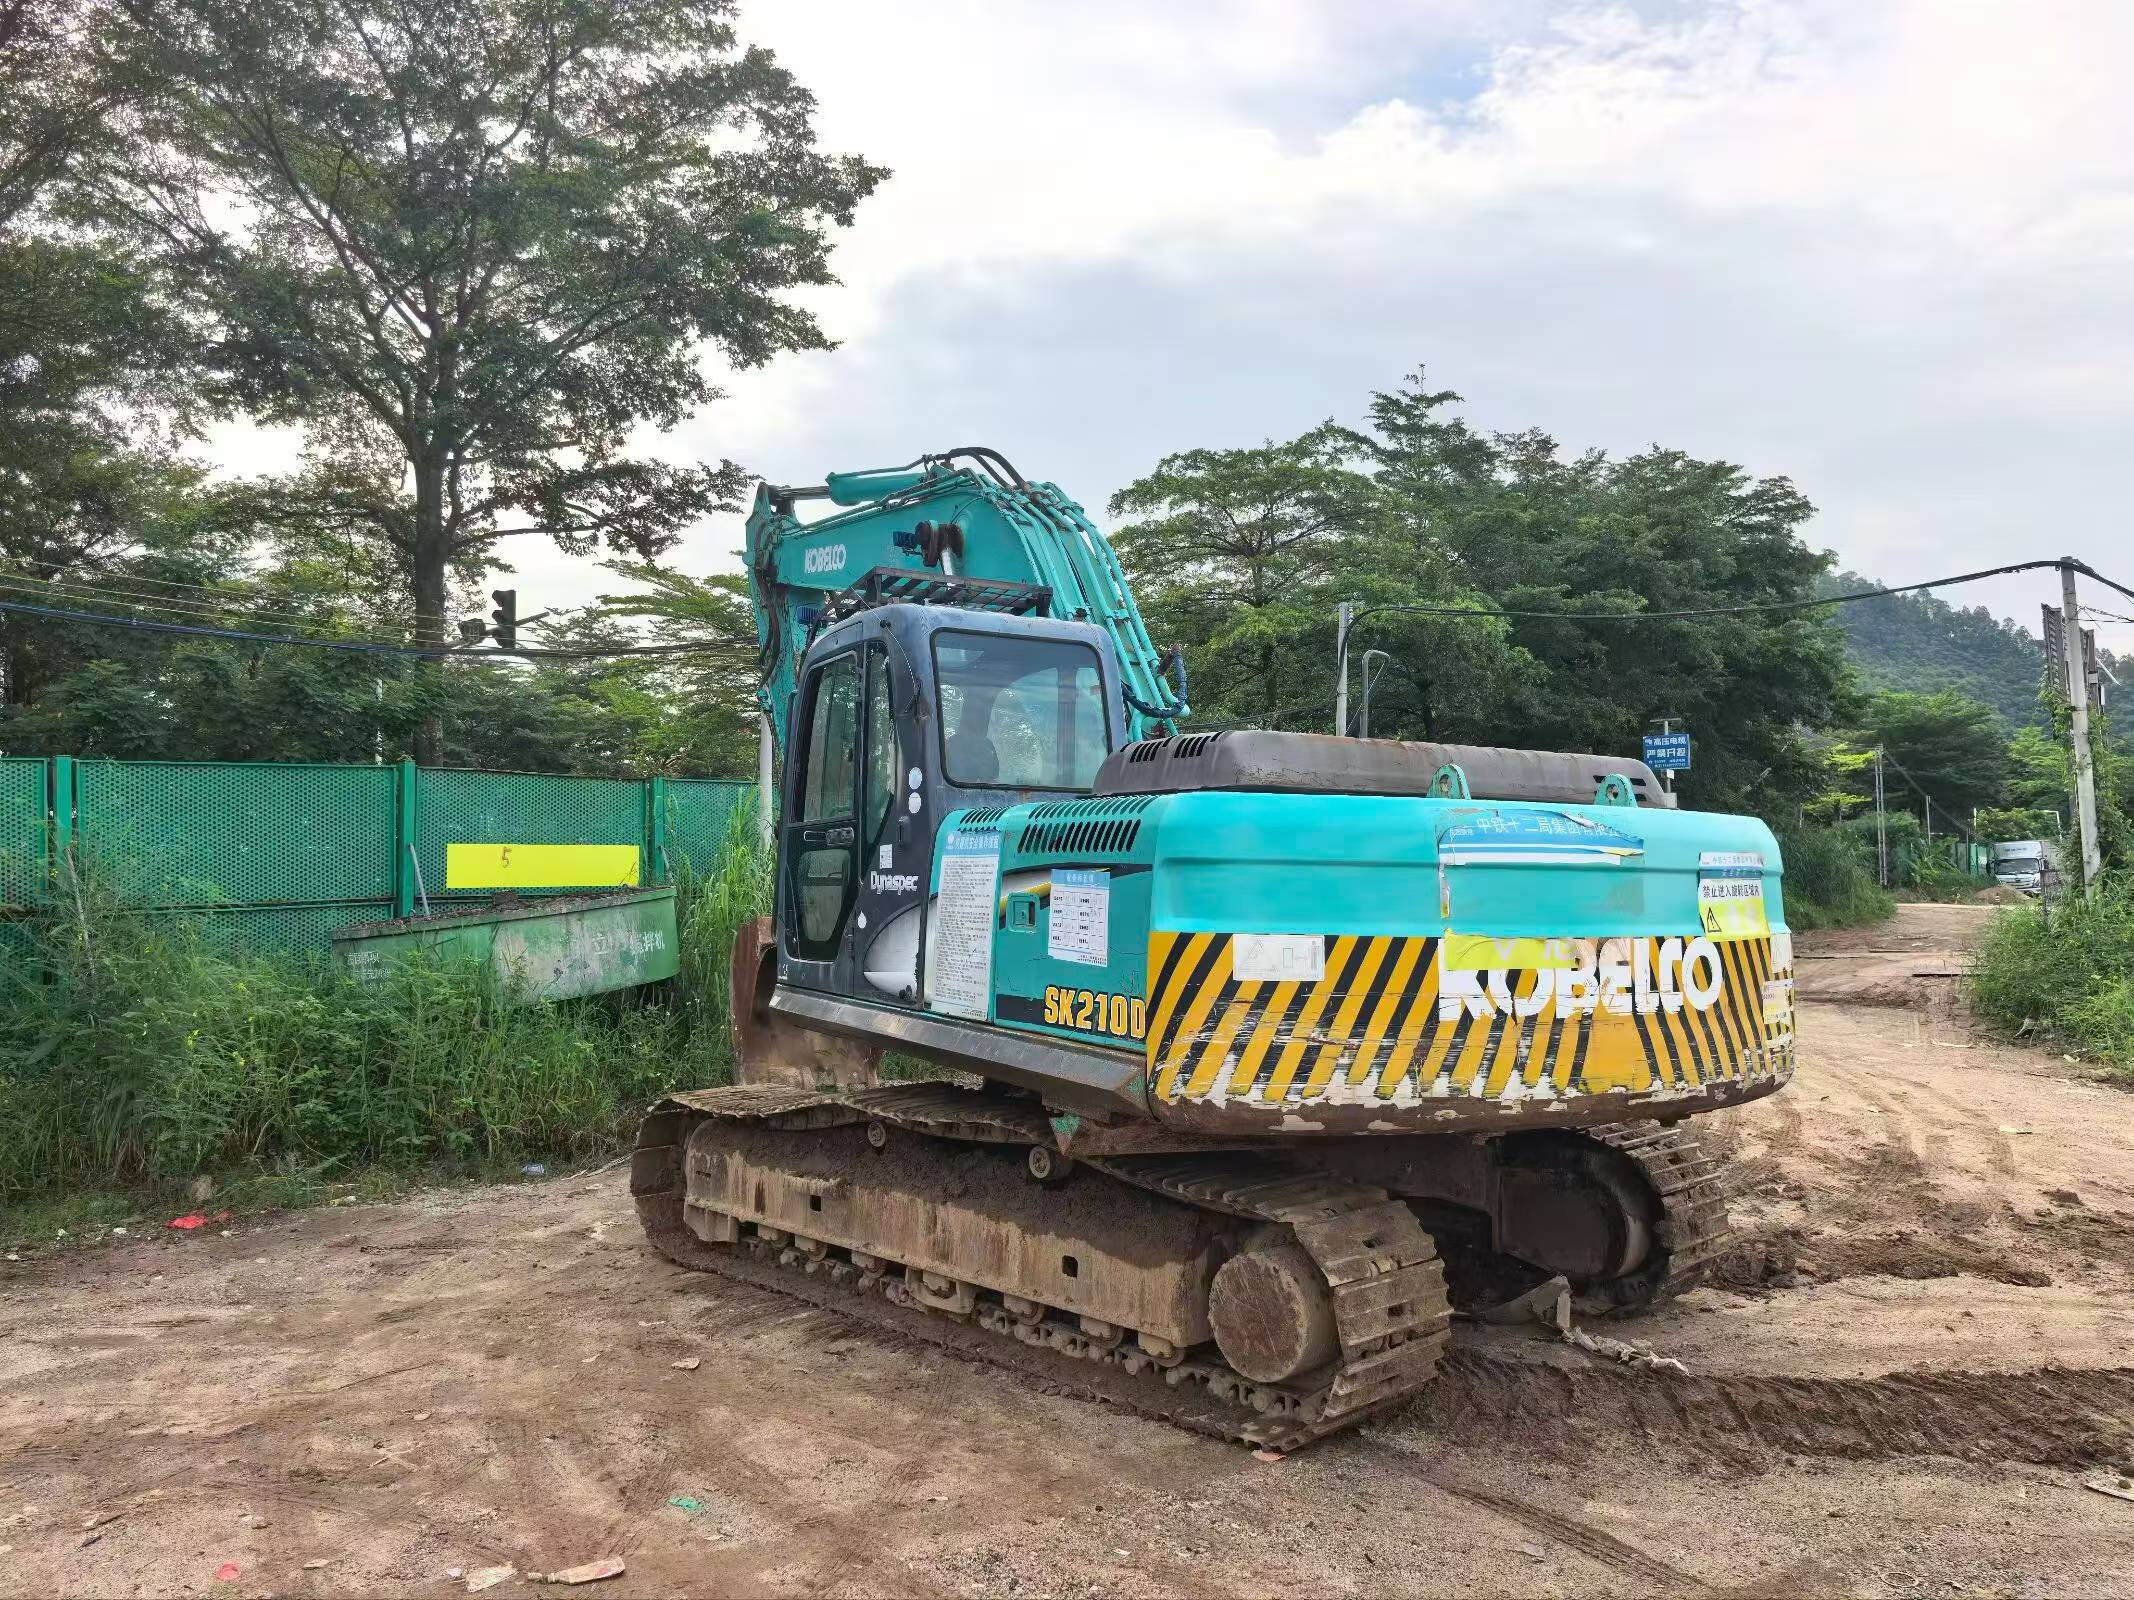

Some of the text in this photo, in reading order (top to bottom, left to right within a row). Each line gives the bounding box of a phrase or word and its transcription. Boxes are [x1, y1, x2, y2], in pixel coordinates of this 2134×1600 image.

[805, 544, 847, 574] KOBELCO
[871, 871, 919, 895] Dynaspec
[1703, 884, 1760, 898] 禁止进入旋转区域内
[1044, 986, 1146, 1039] SK210D
